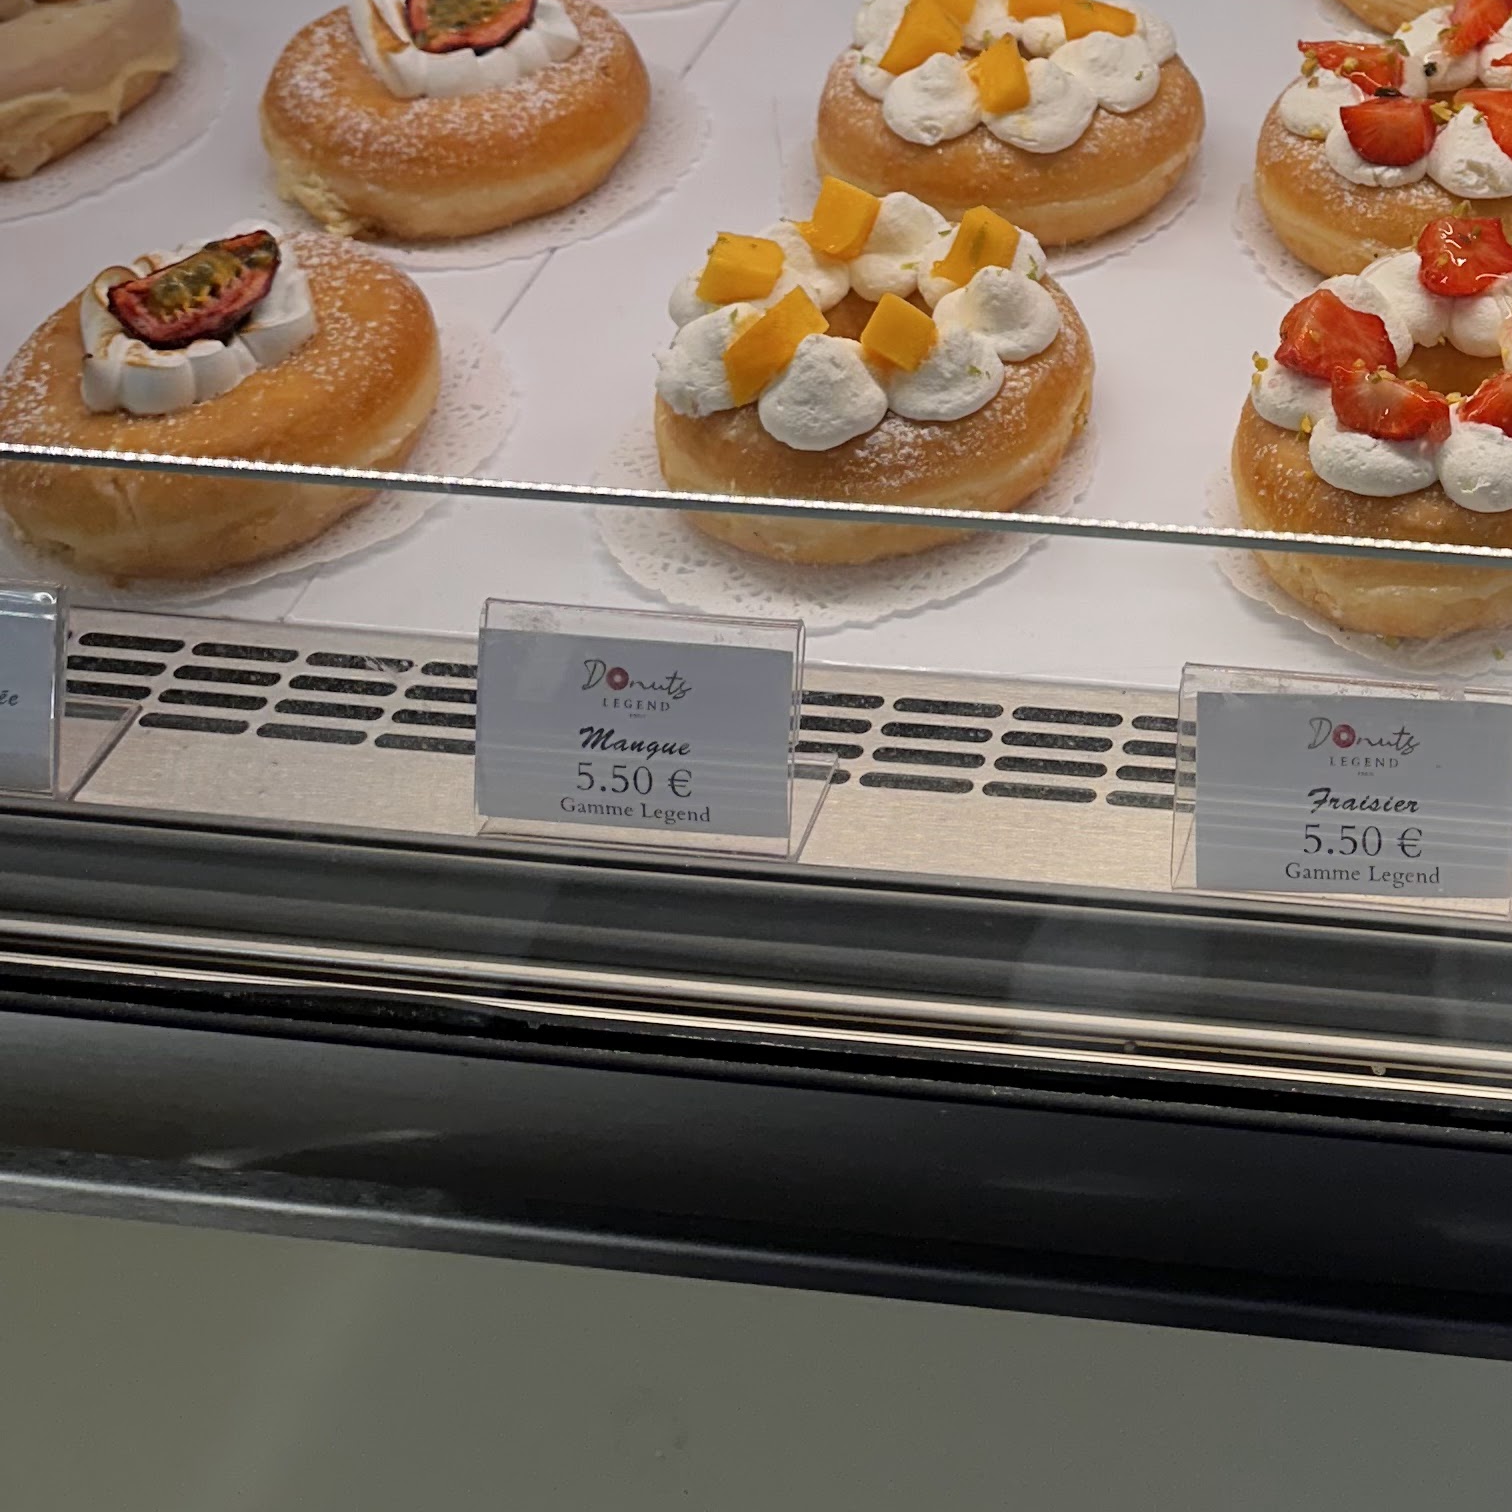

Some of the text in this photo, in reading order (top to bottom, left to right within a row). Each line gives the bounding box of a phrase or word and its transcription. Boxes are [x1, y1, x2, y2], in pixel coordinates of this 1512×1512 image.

[603, 698, 670, 712] LEGEND
[579, 726, 691, 760] Mangue
[1329, 757, 1399, 768] LEGEND
[576, 762, 692, 797] 5.50 €
[560, 796, 710, 825] Gamme Legend
[1307, 787, 1419, 814] Fraisier
[1303, 824, 1423, 858] 5.50 €
[1285, 862, 1440, 889] Gamme Legend
